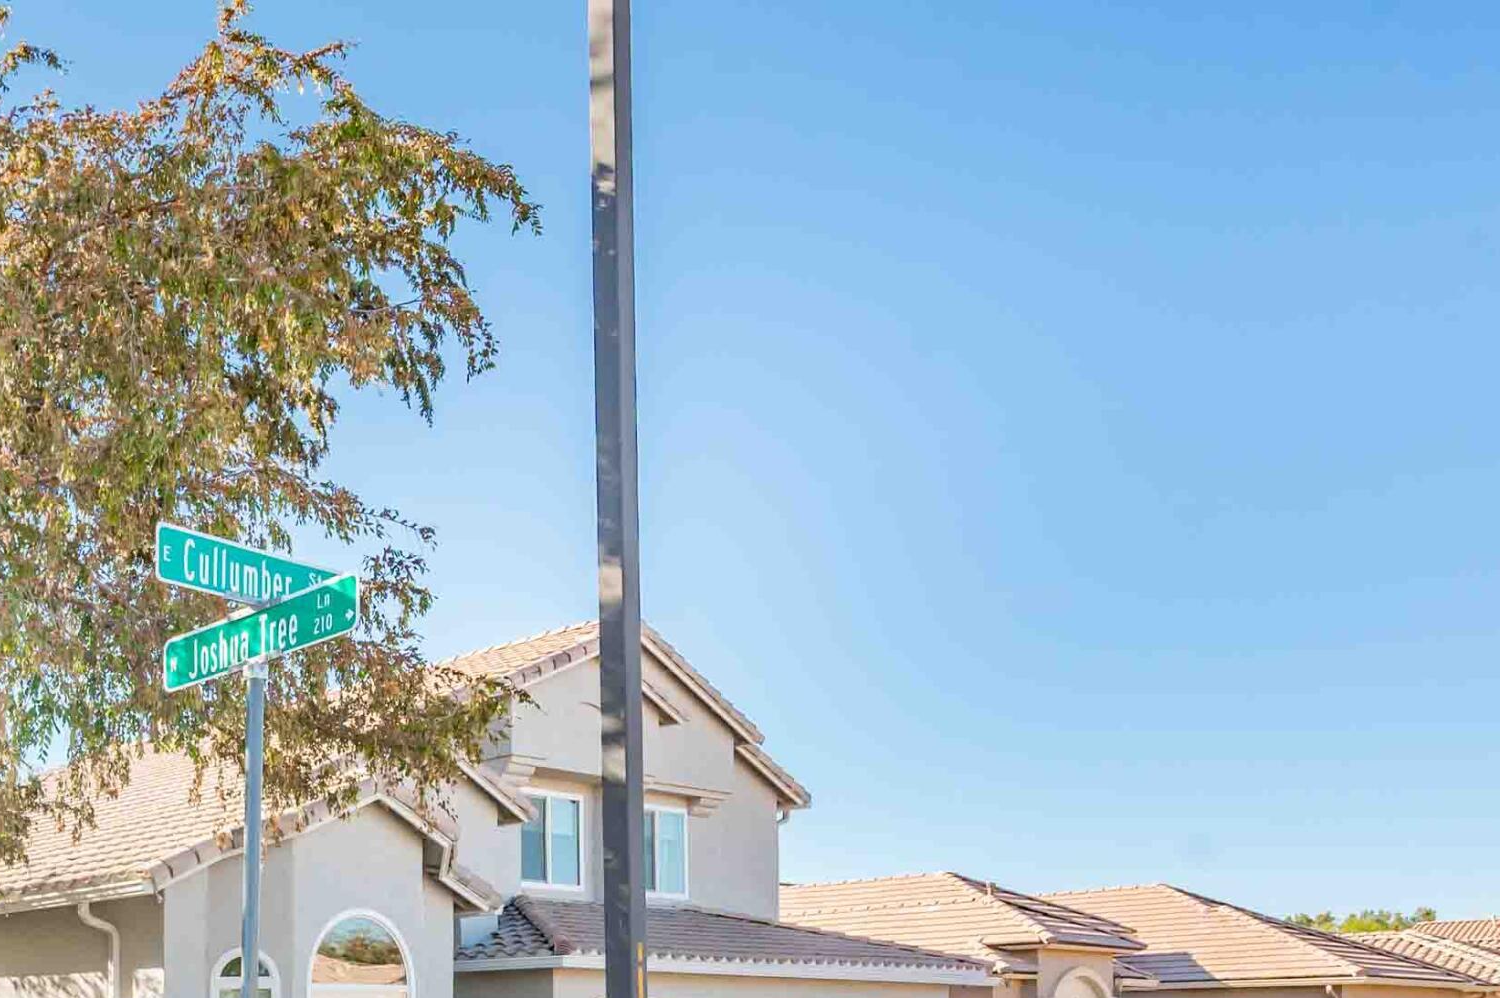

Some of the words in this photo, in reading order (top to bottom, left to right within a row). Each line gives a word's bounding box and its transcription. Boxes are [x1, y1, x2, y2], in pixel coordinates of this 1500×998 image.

[163, 545, 172, 562] E
[183, 538, 293, 599] Cullumber
[188, 629, 249, 680] Joshua
[258, 613, 298, 657] Tree
[317, 593, 331, 609] Ln
[313, 613, 333, 634] 210
